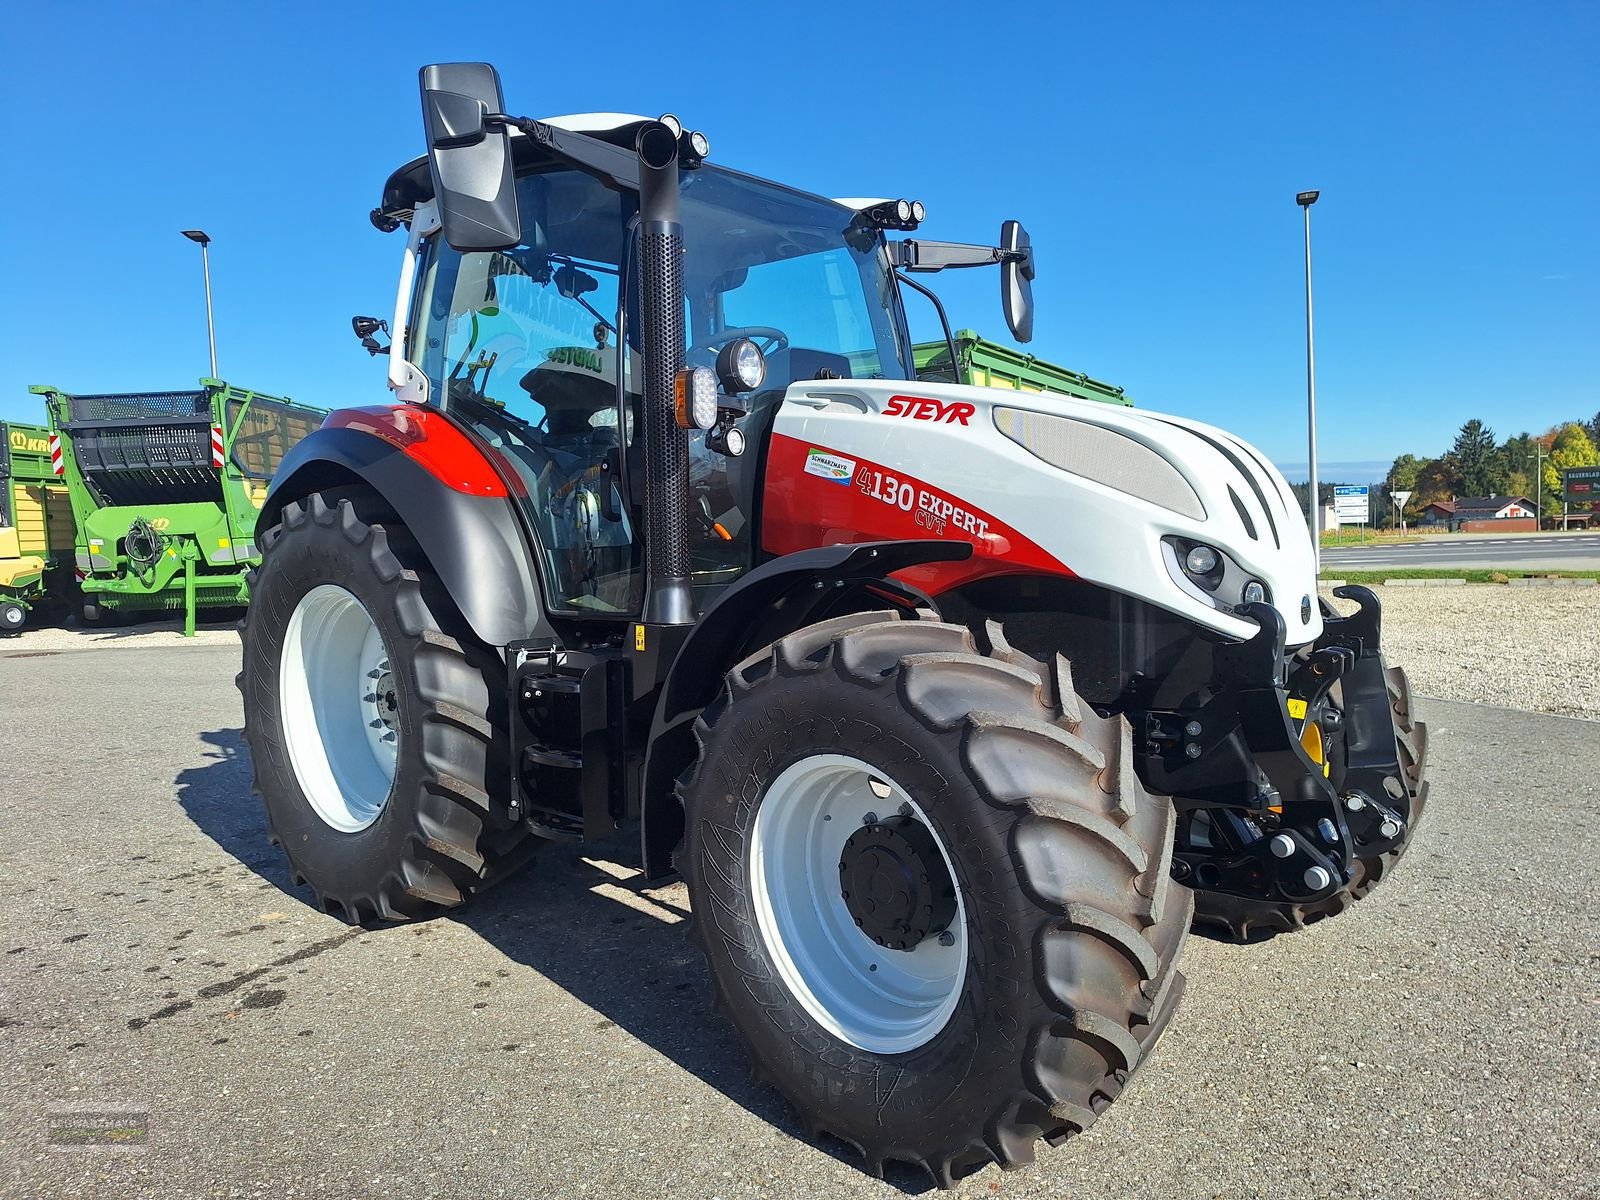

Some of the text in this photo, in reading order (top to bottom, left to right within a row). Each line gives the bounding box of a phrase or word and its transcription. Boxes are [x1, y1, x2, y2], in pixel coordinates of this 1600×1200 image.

[881, 394, 975, 426] STEYR
[811, 455, 848, 471] SCHWARZMAYR
[856, 466, 989, 540] 4130 EXPERT
[914, 508, 946, 536] CVT
